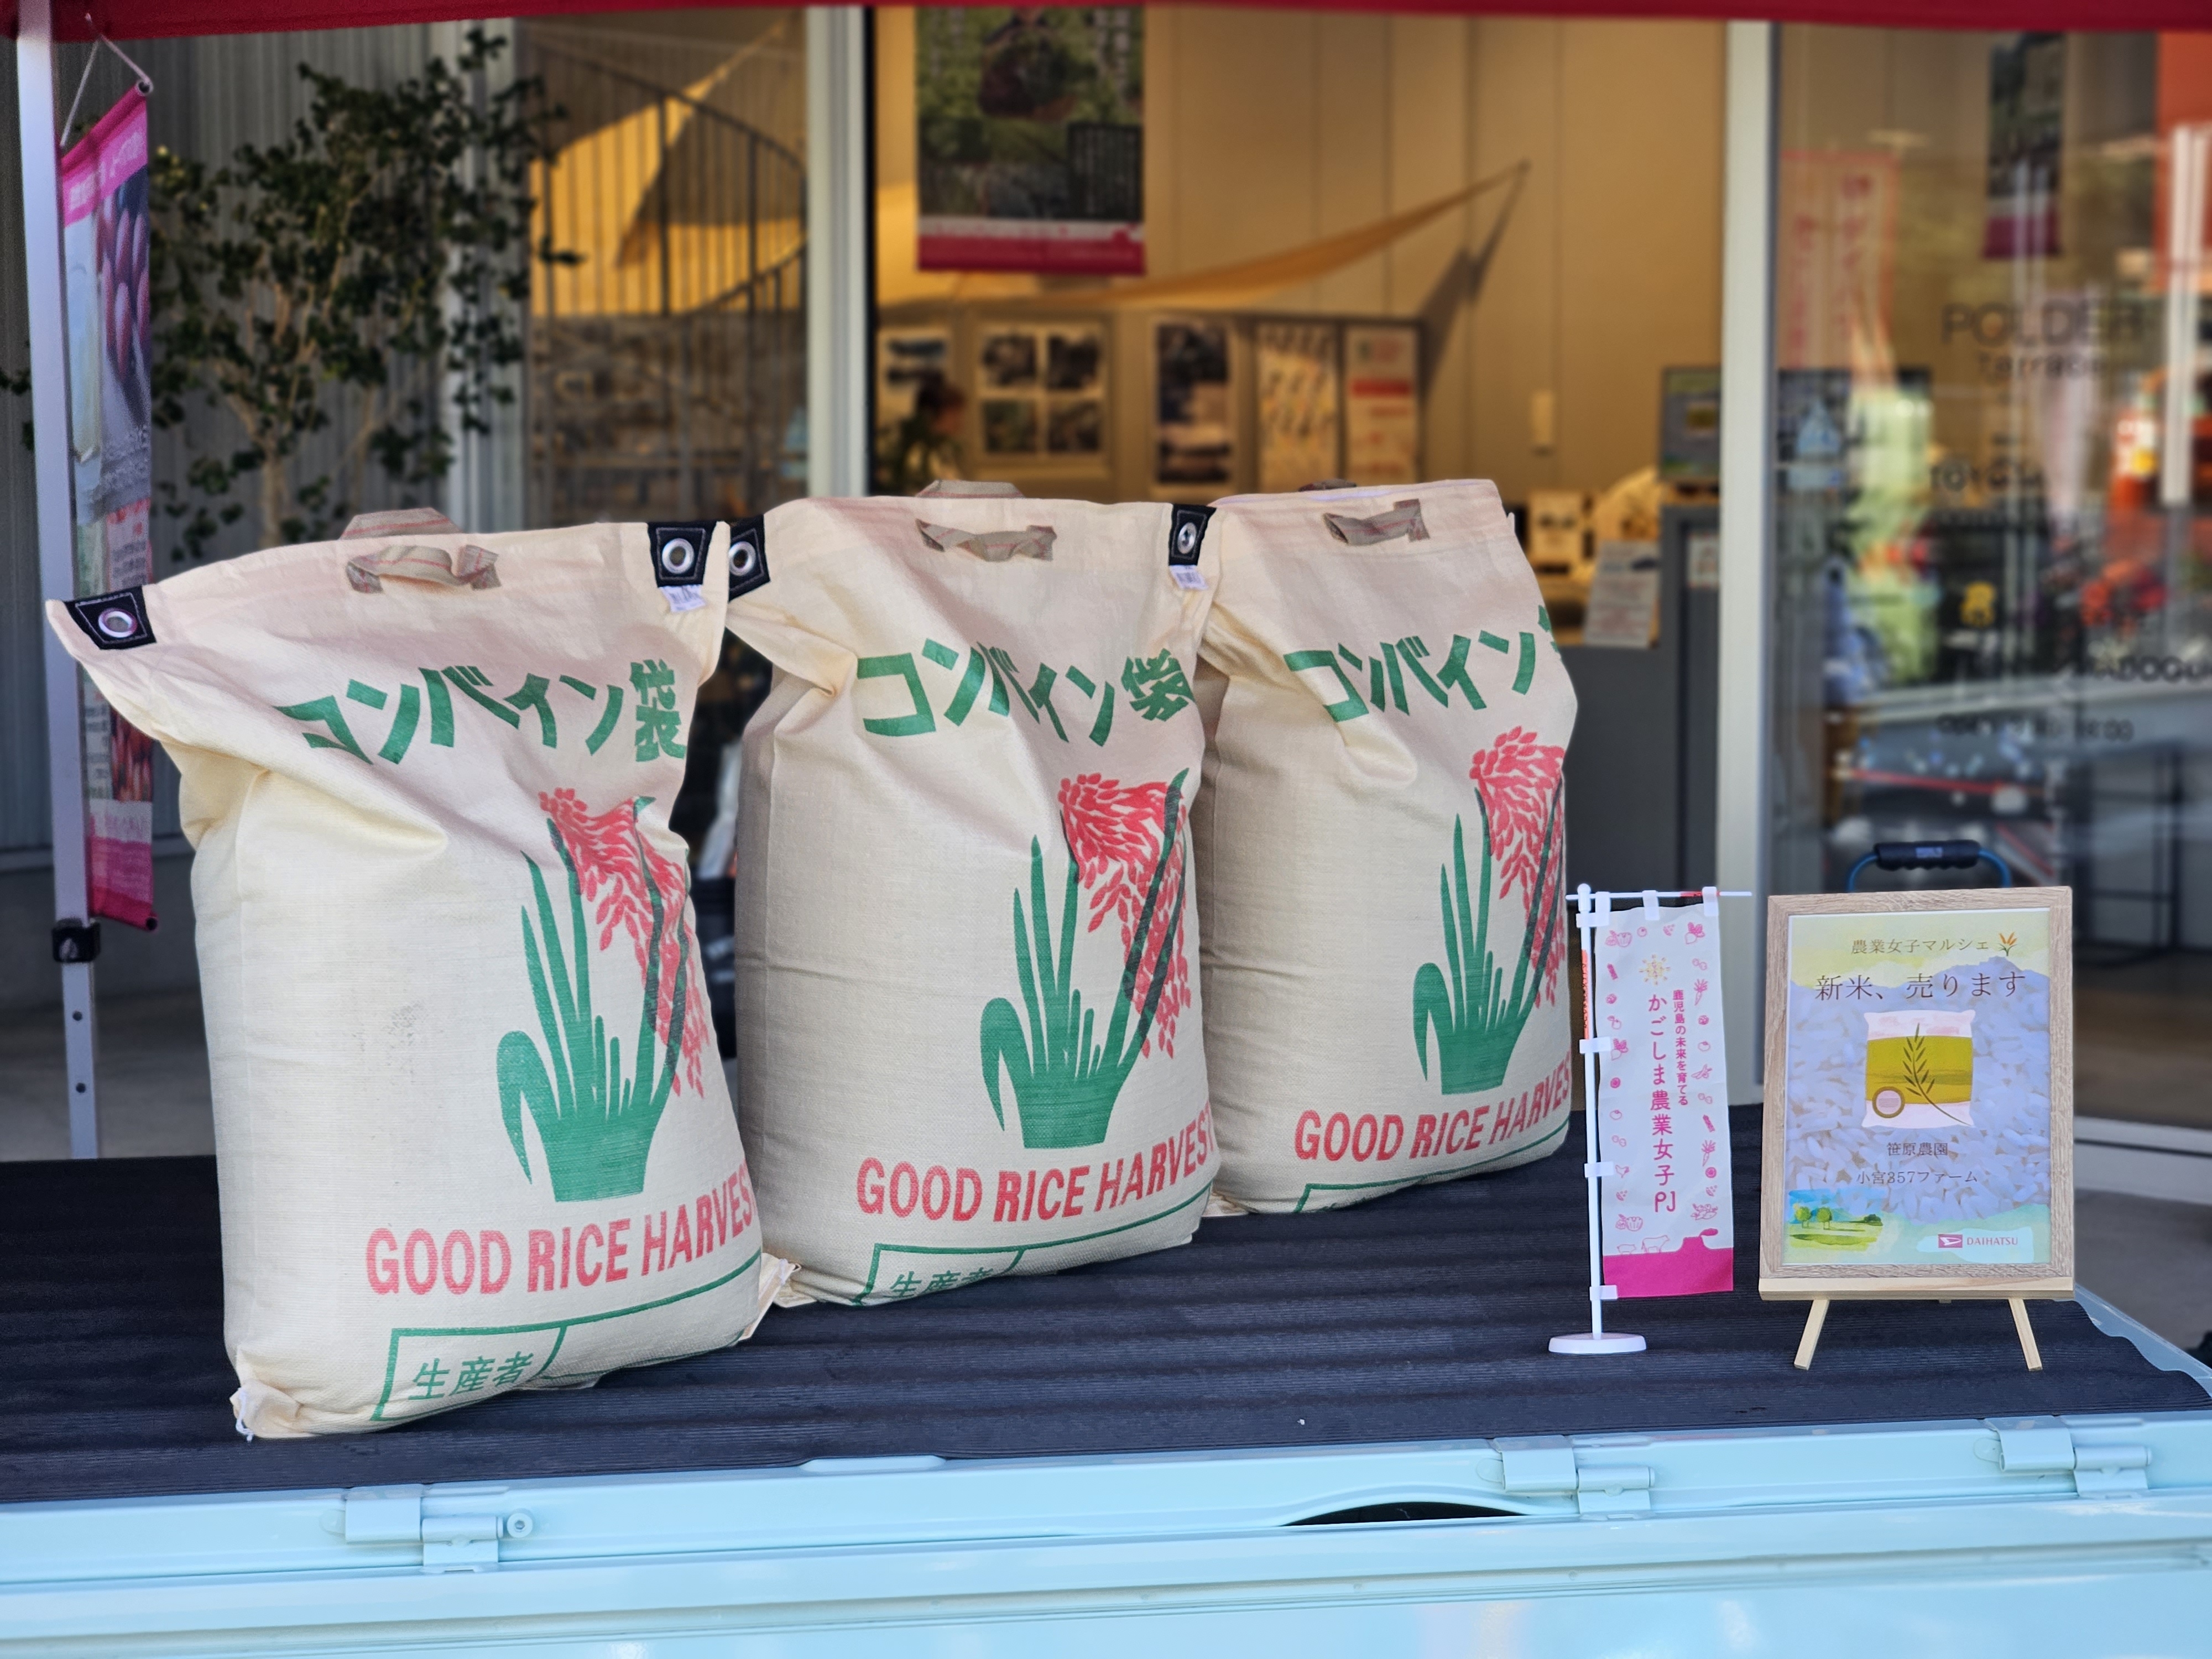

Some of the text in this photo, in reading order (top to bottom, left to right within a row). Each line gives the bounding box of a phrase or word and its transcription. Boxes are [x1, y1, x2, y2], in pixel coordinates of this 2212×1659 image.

[857, 638, 1196, 747] コンバイン袋
[1284, 605, 1561, 722] コンバイン
[272, 659, 686, 764] コンバイン袋
[1815, 971, 2026, 1001] 新米、売ります
[1851, 938, 1989, 954] 農業女子マルシェ
[1673, 989, 1688, 1106] 鹿児島の未来を育てる
[1295, 1049, 1572, 1161] GOOD RICE HARVES
[1648, 994, 1676, 1213] かごしま農業女子PJ
[857, 1157, 983, 1222] GOOD
[993, 1165, 1091, 1222] RICE
[1857, 1171, 1978, 1185] 小宮357ファーム
[1887, 1142, 1948, 1156] 笹原農園
[366, 1157, 757, 1295] GOOD RICE HARVES
[1966, 1237, 2018, 1245] DAIHATSU
[408, 1351, 534, 1401] 生産者
